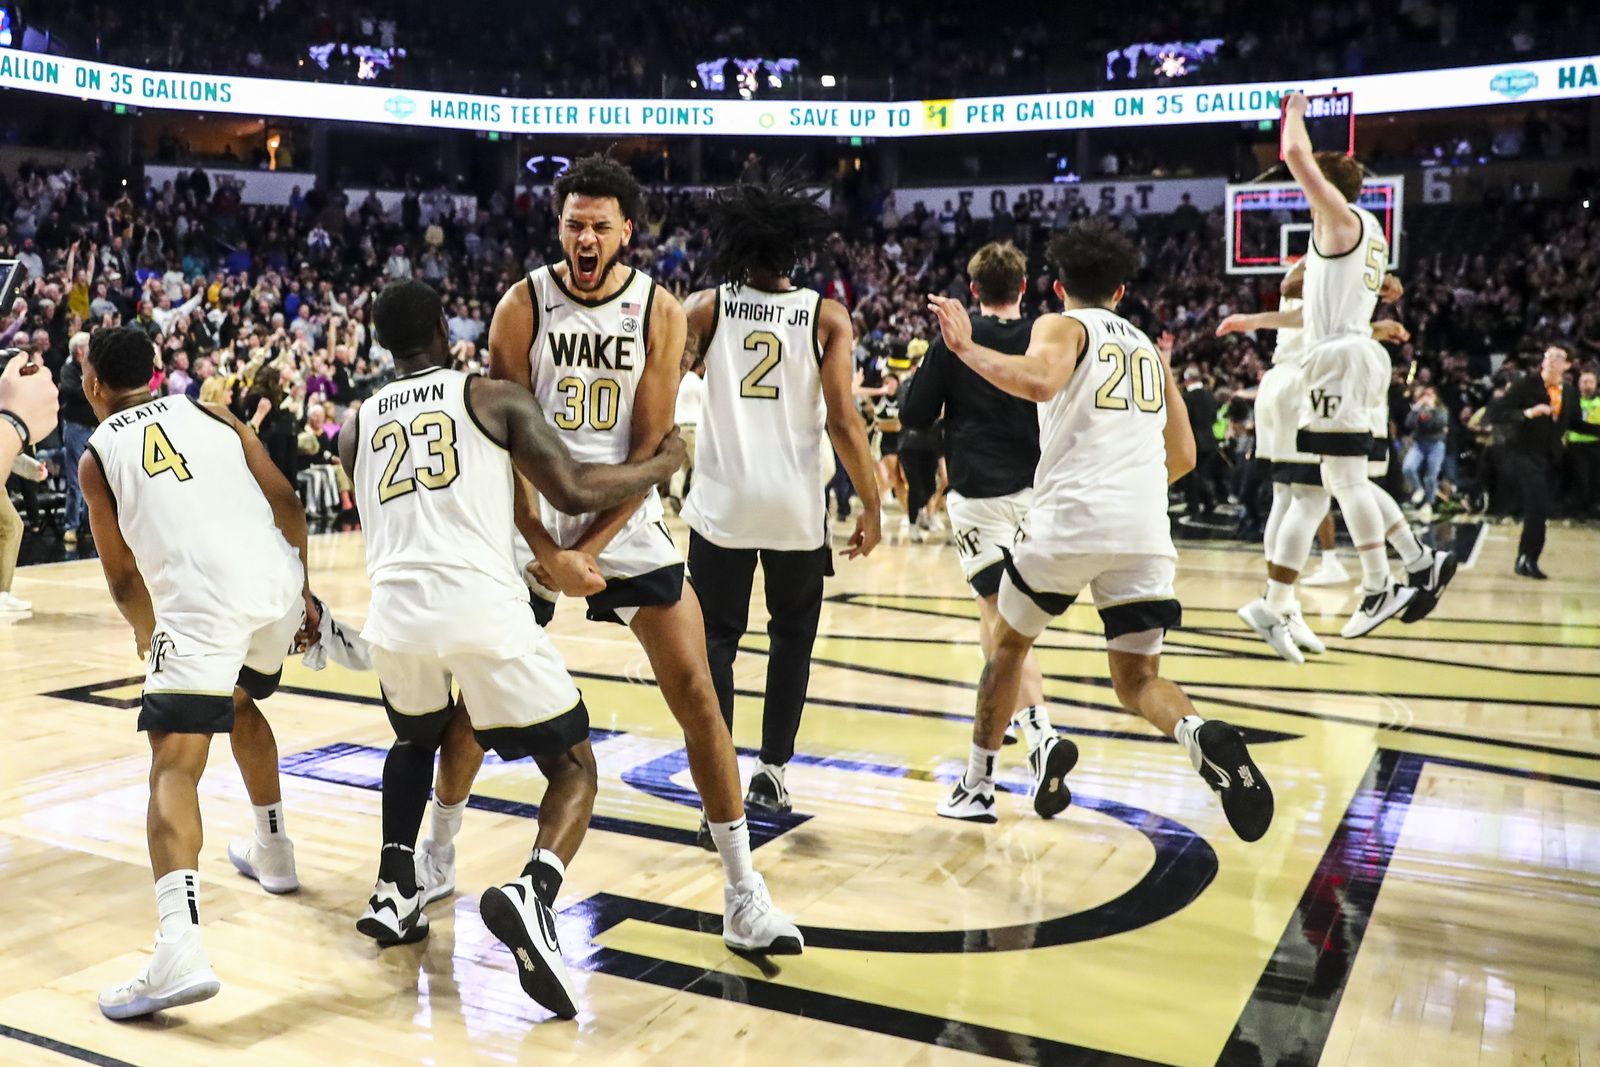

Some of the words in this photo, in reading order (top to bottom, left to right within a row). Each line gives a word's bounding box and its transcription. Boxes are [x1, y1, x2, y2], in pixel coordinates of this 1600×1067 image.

[75, 66, 101, 91] ON
[110, 71, 133, 95] 35
[142, 77, 232, 103] GALLONS
[431, 99, 501, 123] HARRIS
[511, 105, 578, 125] TEETER
[589, 106, 631, 125] FUEL
[642, 106, 714, 126] POINTS
[790, 108, 839, 127] SAVE
[850, 109, 876, 127] UP
[887, 108, 910, 128] TO
[928, 105, 947, 127] $1
[966, 103, 1005, 124] PER
[1016, 99, 1095, 122] GALLON
[1114, 96, 1144, 117] ON
[1156, 94, 1183, 115] 35
[1196, 89, 1296, 113] GALLON
[958, 184, 1154, 214] FOREST
[724, 301, 785, 323] WRIGHT
[788, 310, 809, 326] JR
[548, 332, 635, 371] WAKE
[740, 330, 782, 399] 2
[1095, 343, 1163, 413] 20
[108, 401, 169, 432] NEATH
[378, 383, 444, 415] BROWN
[554, 376, 621, 431] 30
[142, 422, 193, 482] 4
[371, 410, 460, 505] 23
